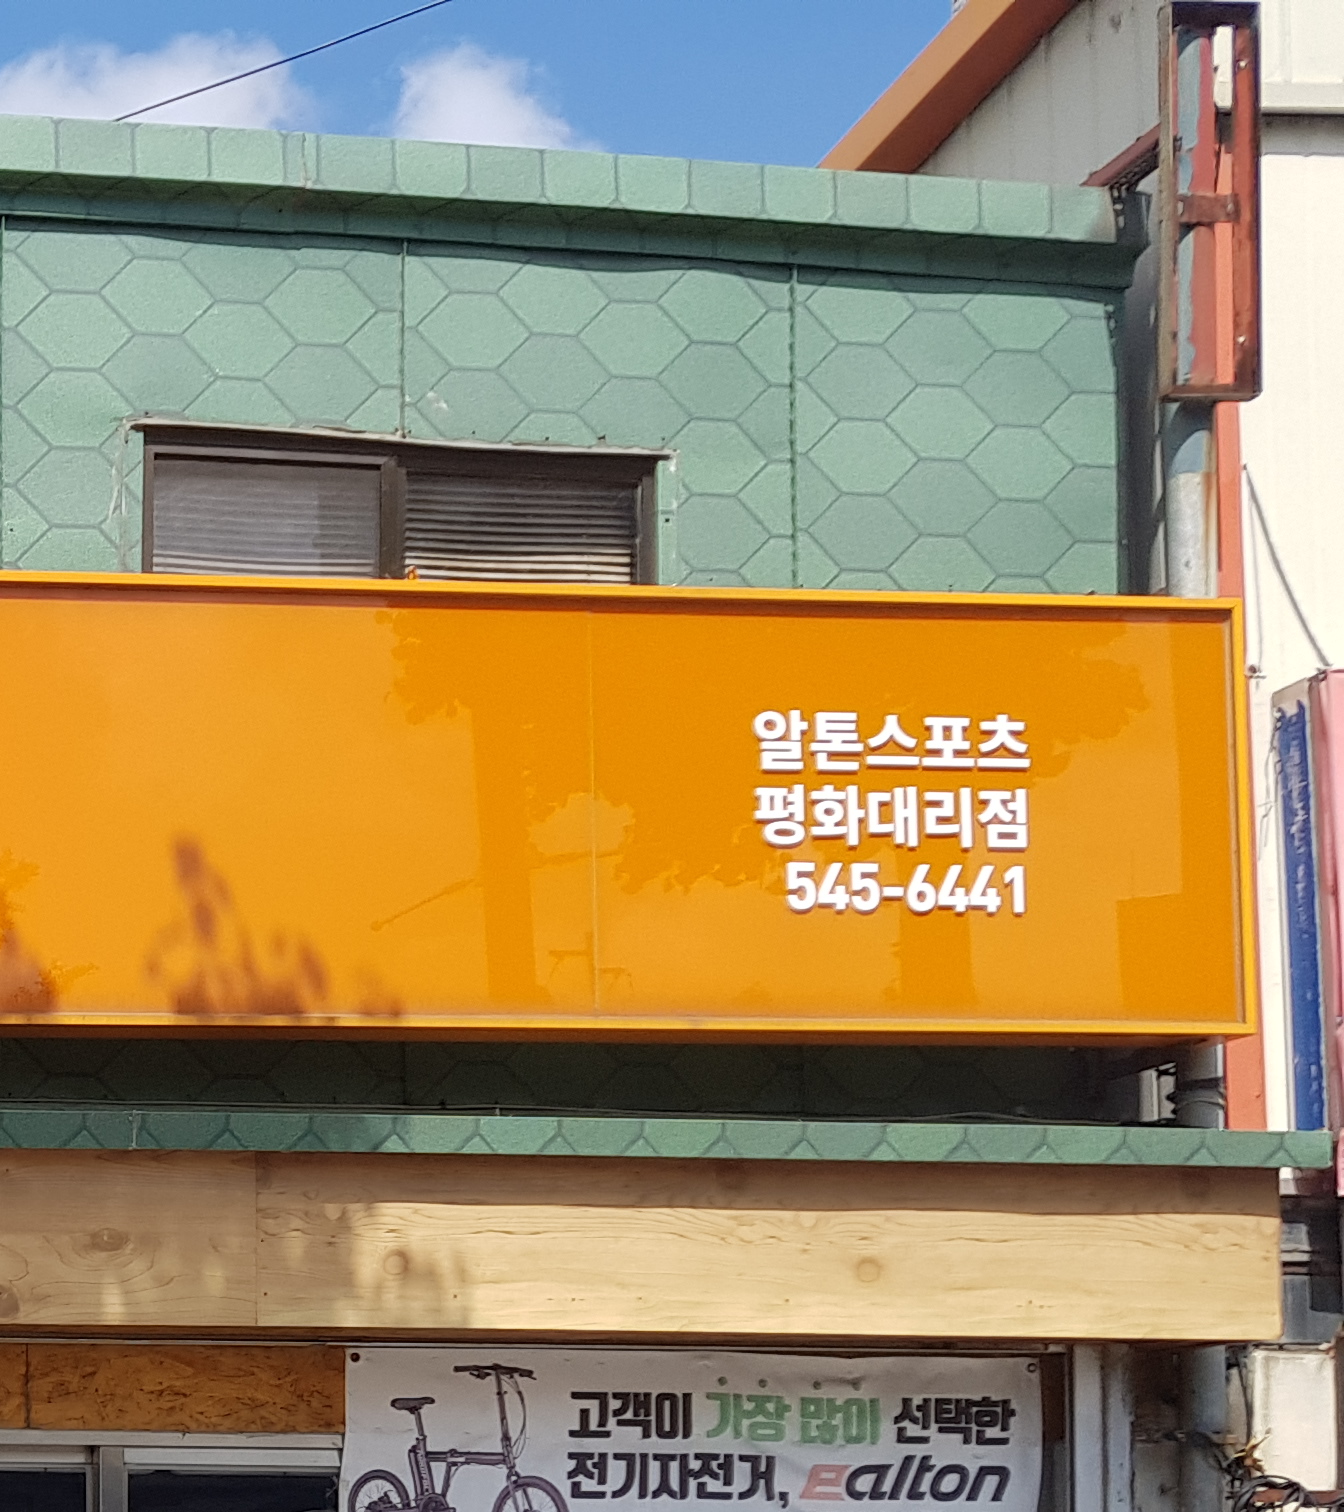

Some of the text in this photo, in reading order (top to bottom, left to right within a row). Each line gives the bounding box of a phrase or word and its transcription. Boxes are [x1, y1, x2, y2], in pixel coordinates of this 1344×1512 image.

[753, 709, 1031, 771] 알톤스포츠
[753, 784, 1030, 850] 평화대리점
[785, 861, 1026, 915] 545-6441
[568, 1391, 1016, 1445] 고객이 가장 많이 선택한
[567, 1452, 789, 1509] 전기자전거,
